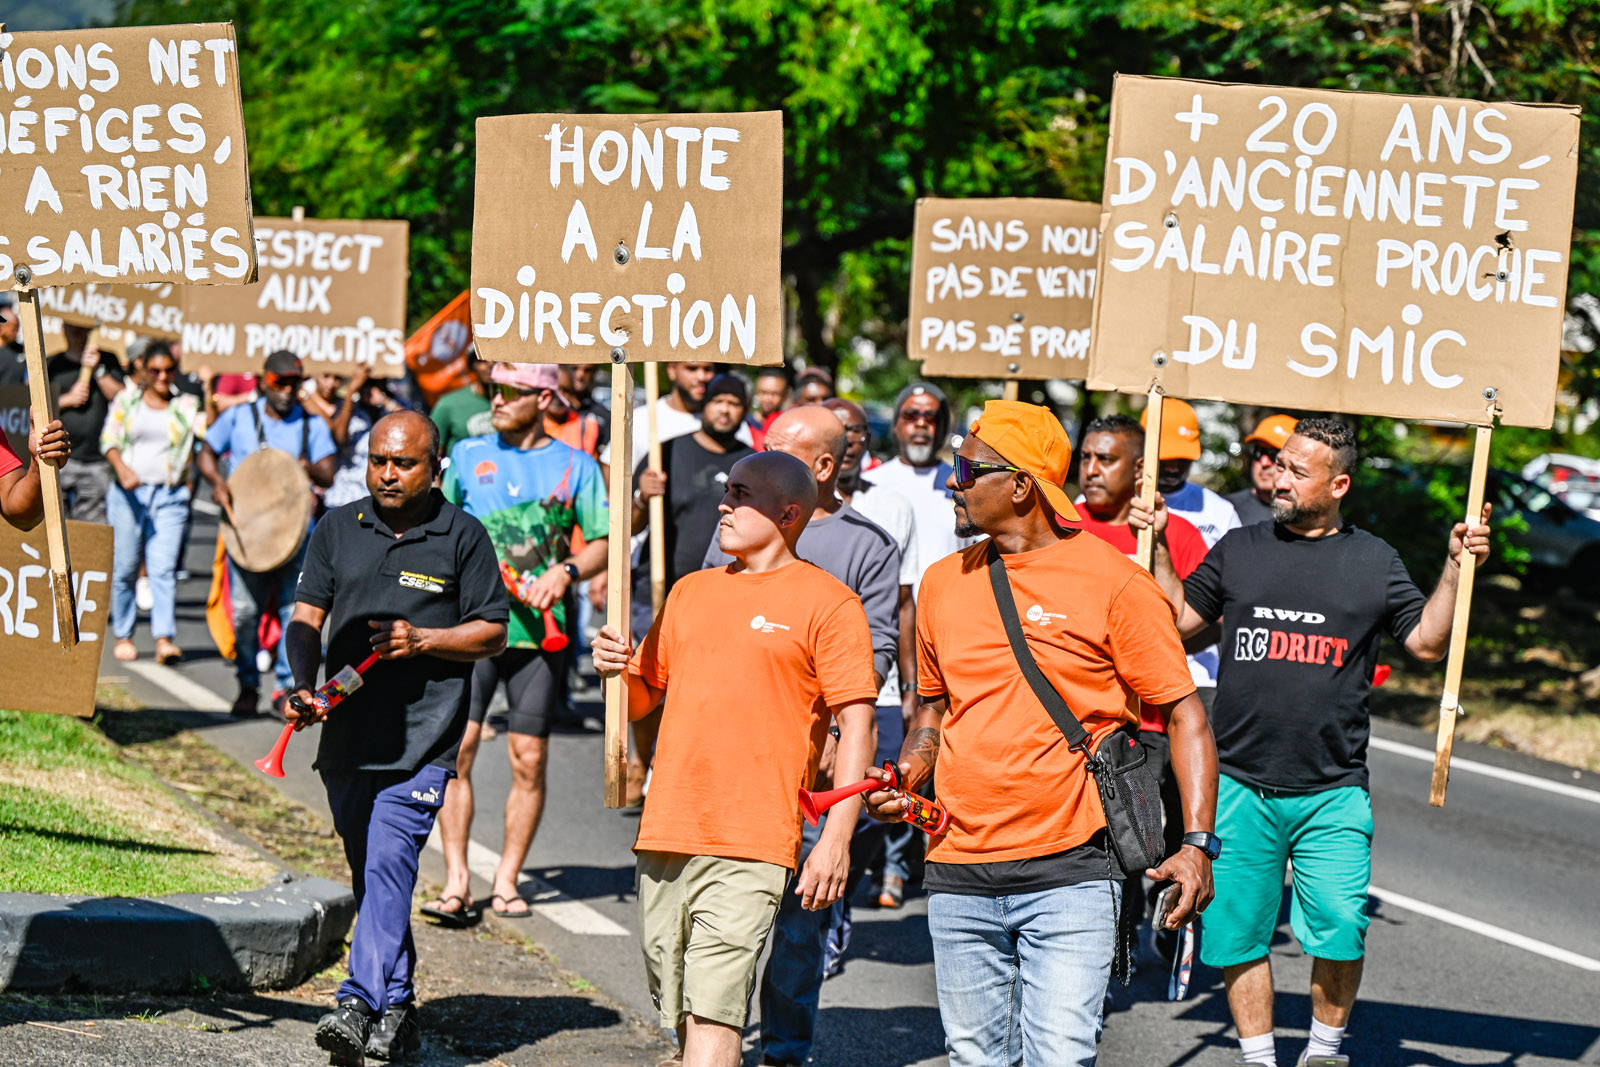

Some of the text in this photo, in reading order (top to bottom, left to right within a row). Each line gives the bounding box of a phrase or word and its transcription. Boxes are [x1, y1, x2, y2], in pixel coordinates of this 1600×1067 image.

[148, 38, 235, 89] NET
[1246, 96, 1338, 155] 20
[1380, 104, 1512, 165] ANS
[541, 121, 742, 192] HONTE
[25, 165, 63, 216] A
[255, 228, 384, 274] ESPECT
[561, 199, 702, 264] A LA
[930, 215, 1102, 256] SANS NOU
[257, 272, 333, 315] AUX
[926, 262, 984, 304] PAS
[988, 265, 1033, 298] DE
[1376, 238, 1562, 308] PROCHE
[128, 301, 145, 326] A
[920, 316, 977, 353] PAS
[979, 323, 1025, 357] DE
[180, 322, 236, 356] NON
[1172, 315, 1258, 370] DU
[1252, 606, 1326, 624] RWD
